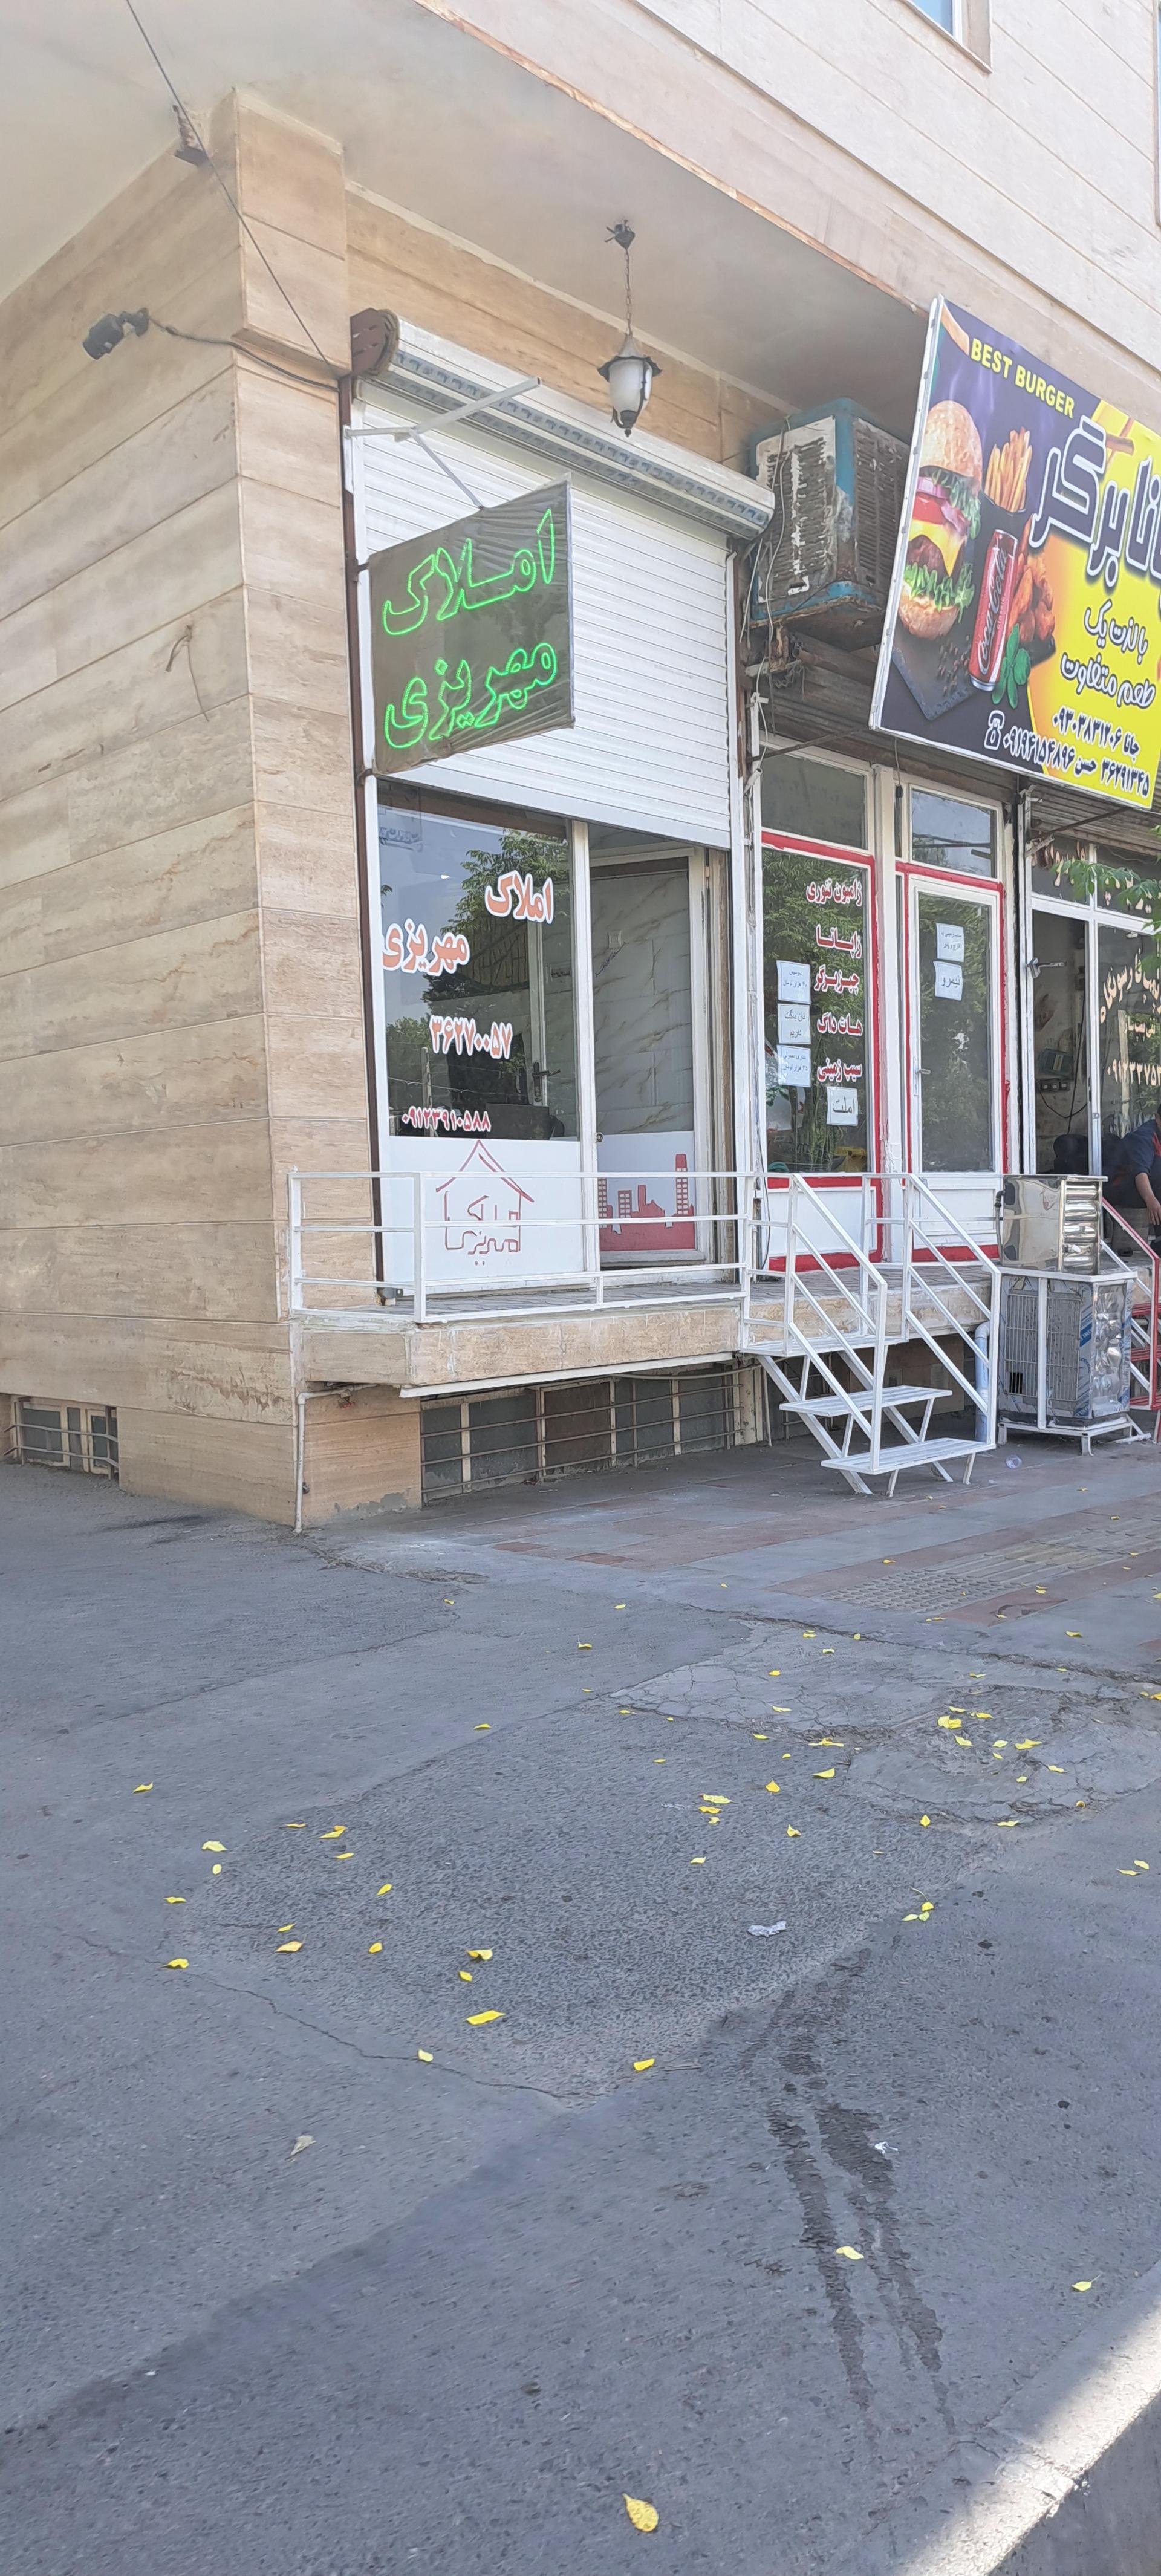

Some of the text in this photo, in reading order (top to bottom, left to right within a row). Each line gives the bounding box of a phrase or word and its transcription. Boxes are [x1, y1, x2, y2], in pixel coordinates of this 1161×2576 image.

[970, 337, 1075, 420] BEST BURGER
[383, 509, 556, 635] املاک
[1084, 598, 1113, 649] یک
[1108, 616, 1139, 654] لذت
[385, 642, 557, 749] مهریزی
[1060, 652, 1156, 709] طعم متفاوت
[1073, 756, 1098, 778] حسن
[1123, 731, 1140, 763] جانا
[484, 870, 554, 924] املاک
[806, 878, 833, 905] تنوری
[382, 918, 470, 977] مهریزی
[429, 1015, 513, 1059] ۳۶۲۷۰۰۵۷
[817, 1012, 863, 1036] هات داگ
[817, 1057, 863, 1082] سیب زمینی
[402, 1106, 491, 1132] ۰۹۱۲۳۹۱۰۵۸۸
[832, 1096, 855, 1114] املت
